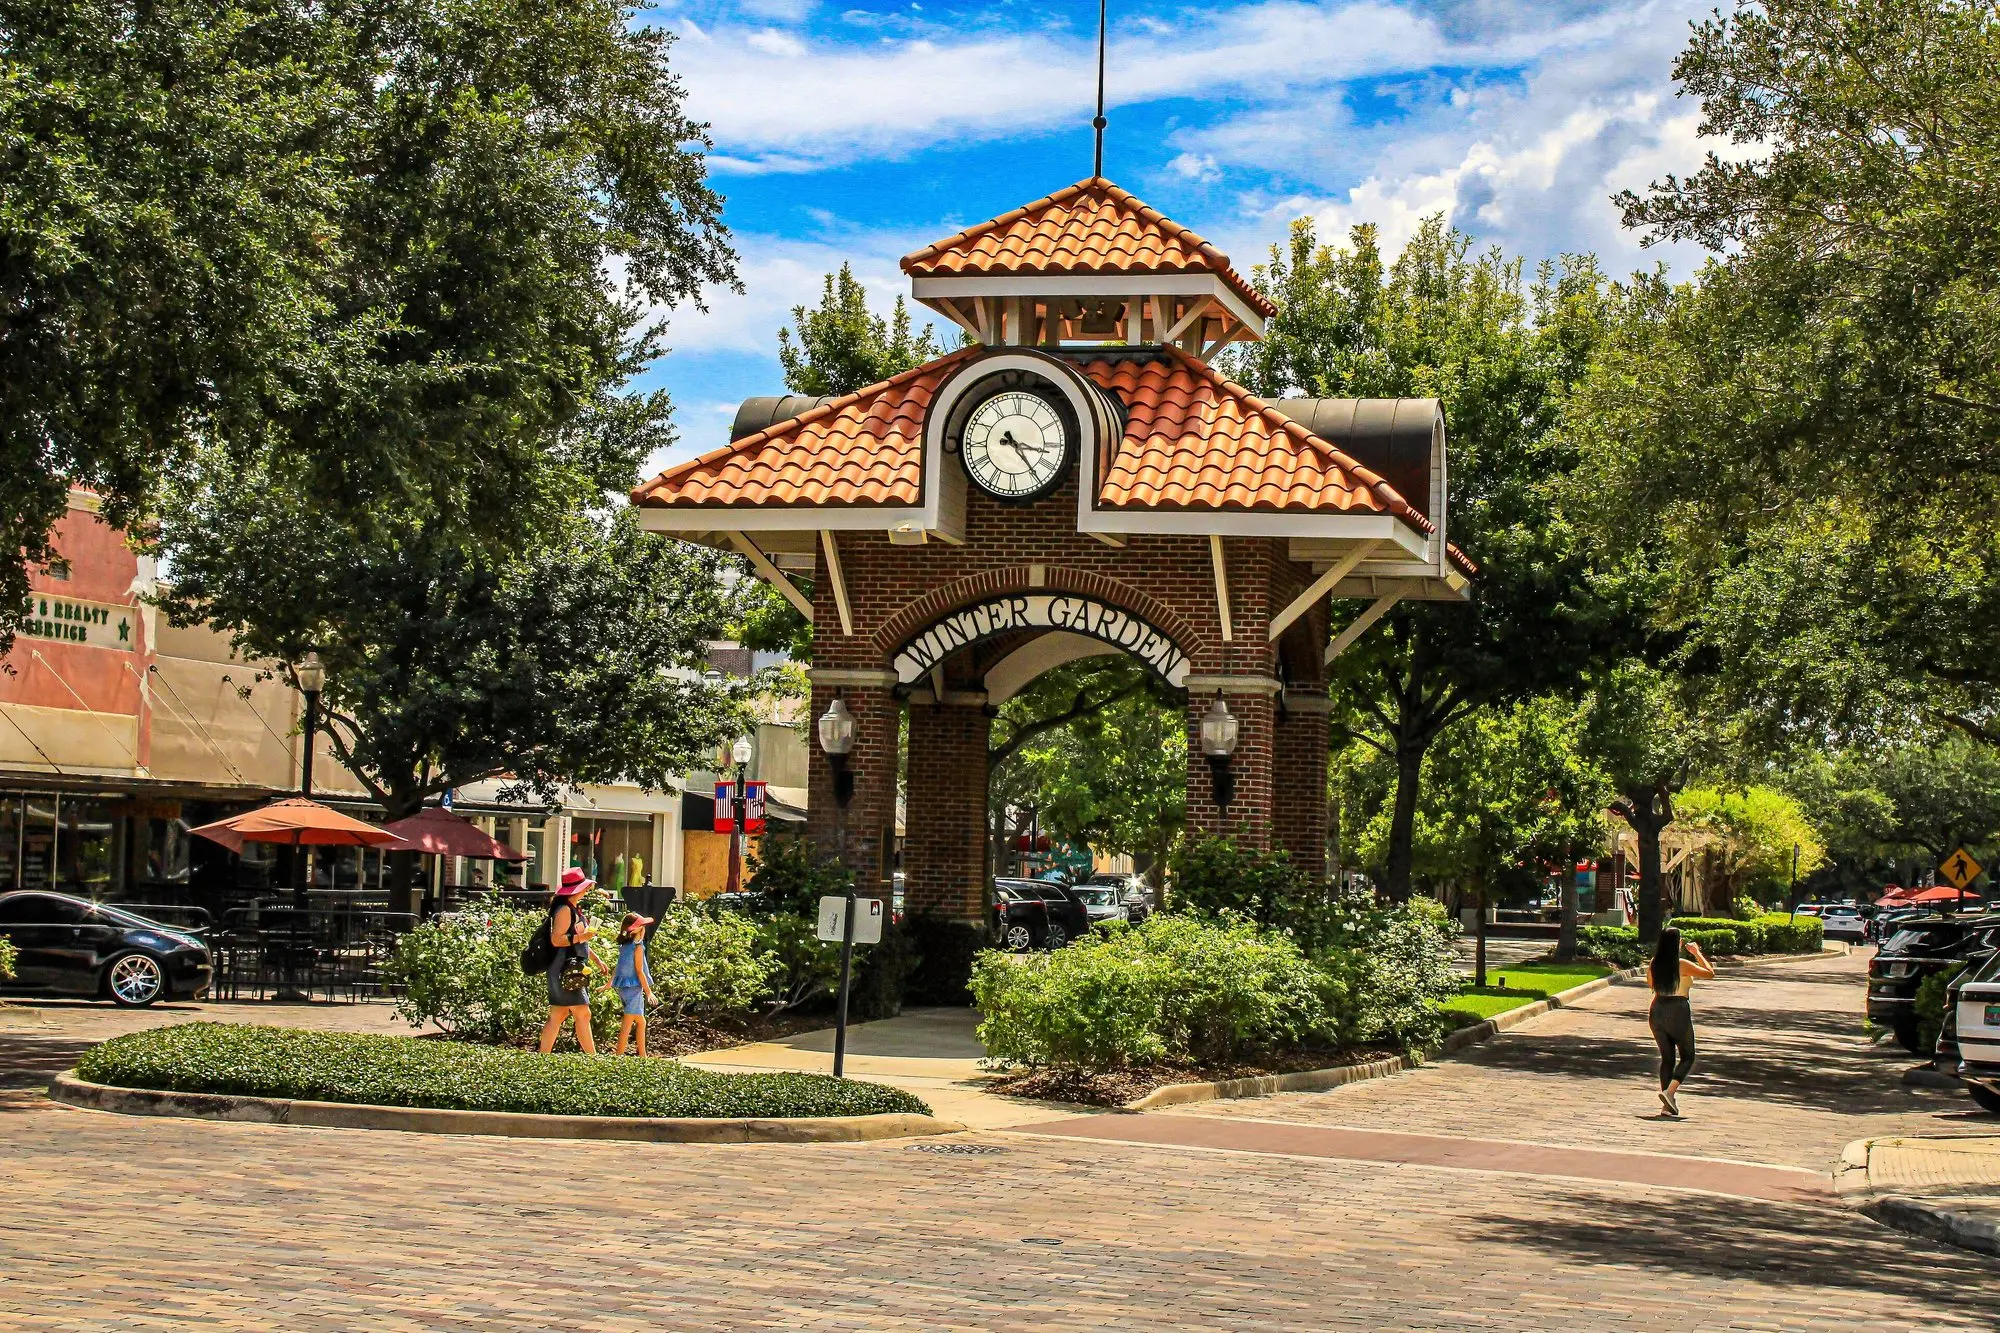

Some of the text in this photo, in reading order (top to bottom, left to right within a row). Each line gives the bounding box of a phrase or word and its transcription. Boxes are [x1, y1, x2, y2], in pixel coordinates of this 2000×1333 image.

[54, 602, 109, 625] REALTY
[904, 597, 1182, 675] WINTER GARDEN
